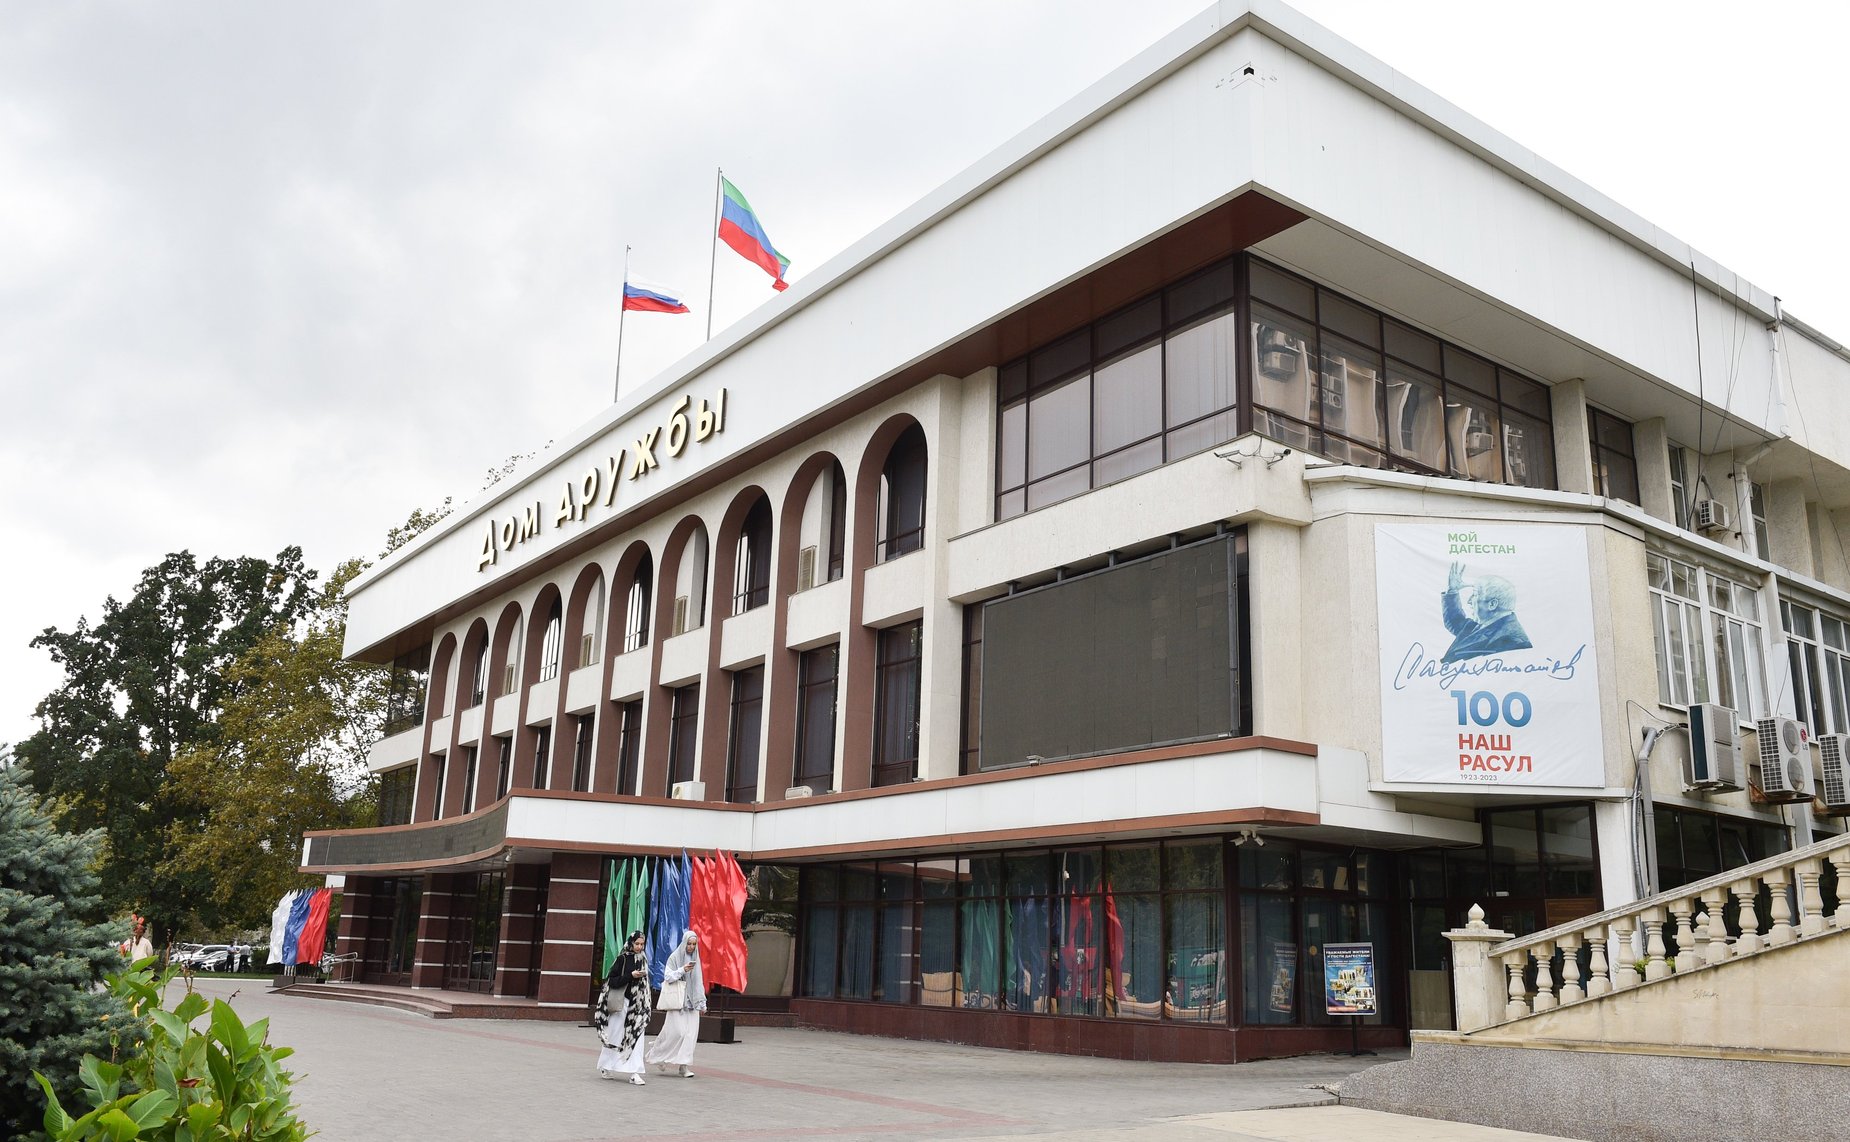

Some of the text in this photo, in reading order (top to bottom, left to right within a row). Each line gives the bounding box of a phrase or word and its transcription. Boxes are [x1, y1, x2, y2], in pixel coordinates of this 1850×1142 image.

[477, 501, 541, 572] Дом
[1448, 531, 1478, 542] МОЙ
[1449, 544, 1516, 554] ДАГЕСТАН
[1450, 690, 1532, 727] 100
[1459, 733, 1511, 751] НАШ
[1459, 754, 1532, 772] РАСУЛ
